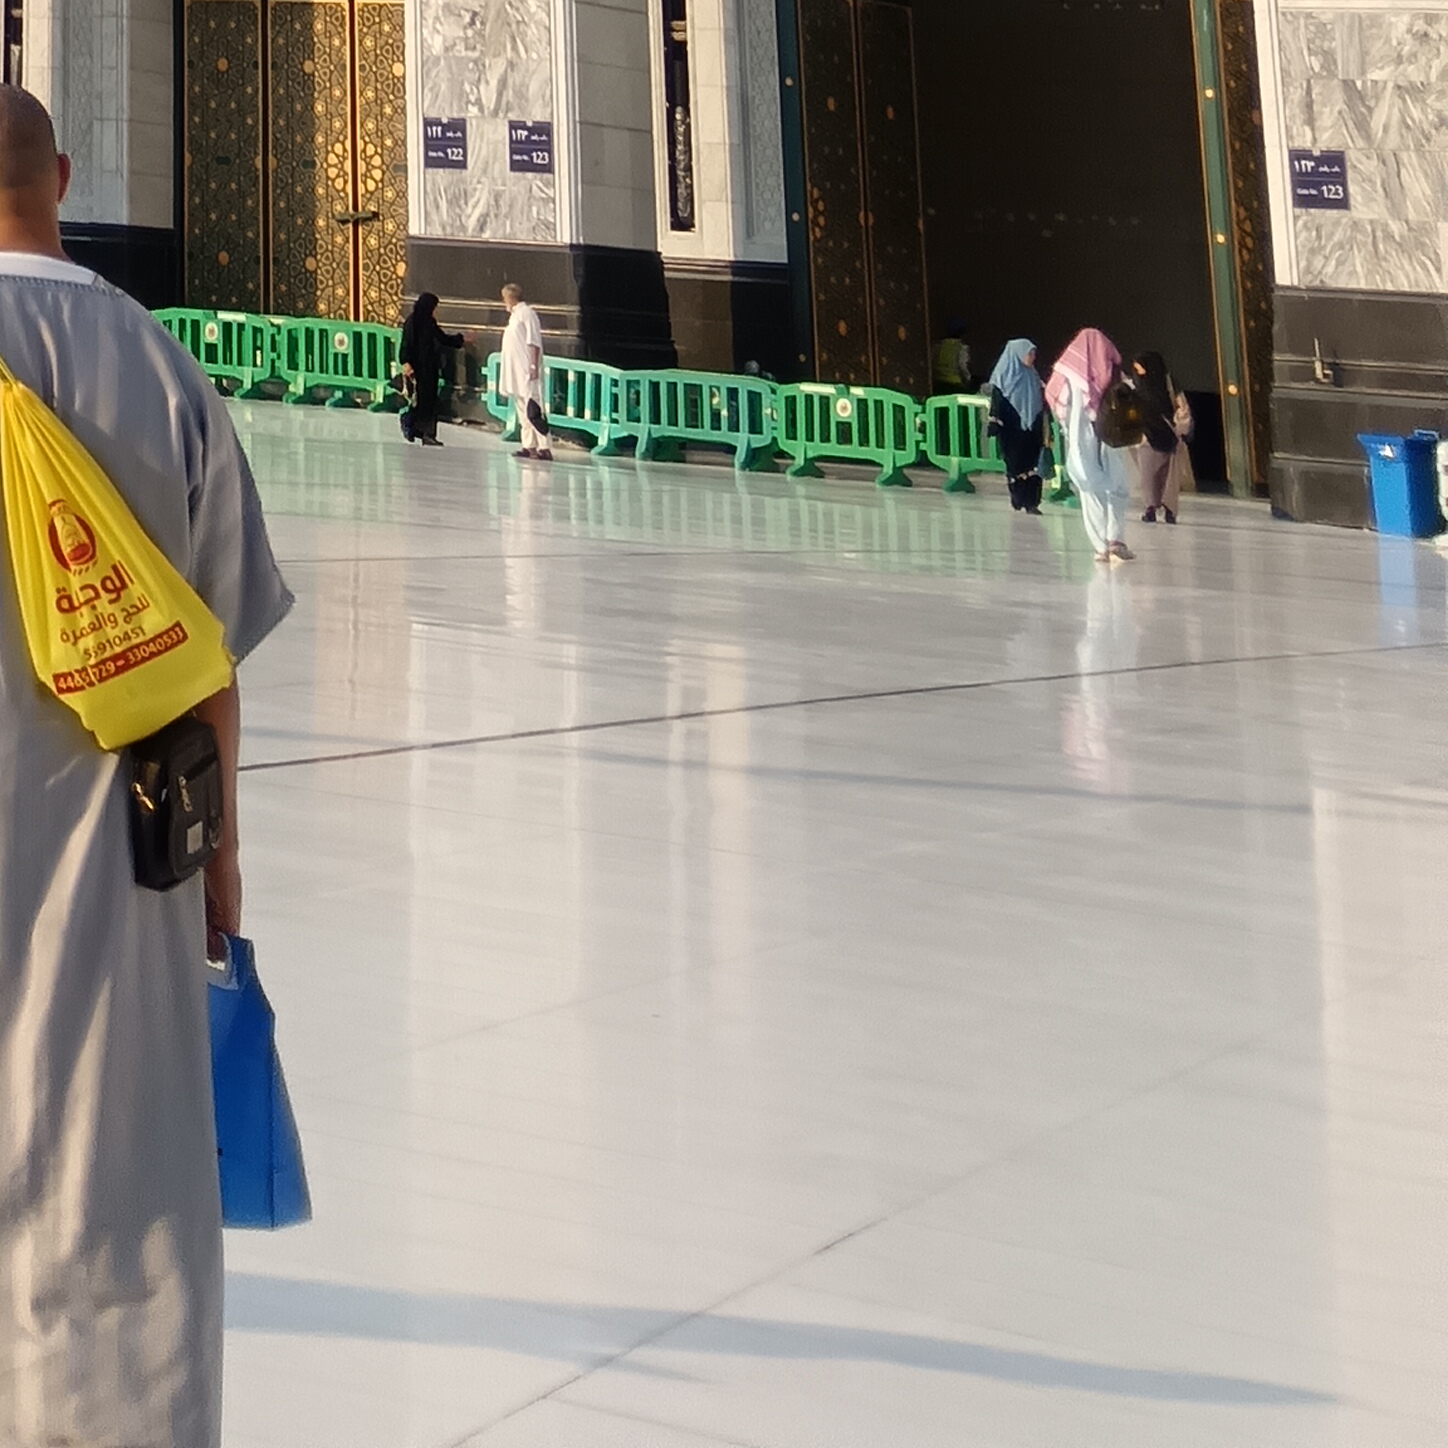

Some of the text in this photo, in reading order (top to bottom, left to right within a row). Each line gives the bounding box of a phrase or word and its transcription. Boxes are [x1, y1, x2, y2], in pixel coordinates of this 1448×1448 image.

[446, 148, 464, 161] 122
[531, 151, 549, 164] 123
[1321, 184, 1344, 199] 123
[55, 560, 135, 618] الوجبة
[60, 593, 151, 647] للحج والعمرة
[127, 627, 185, 664] 33040533
